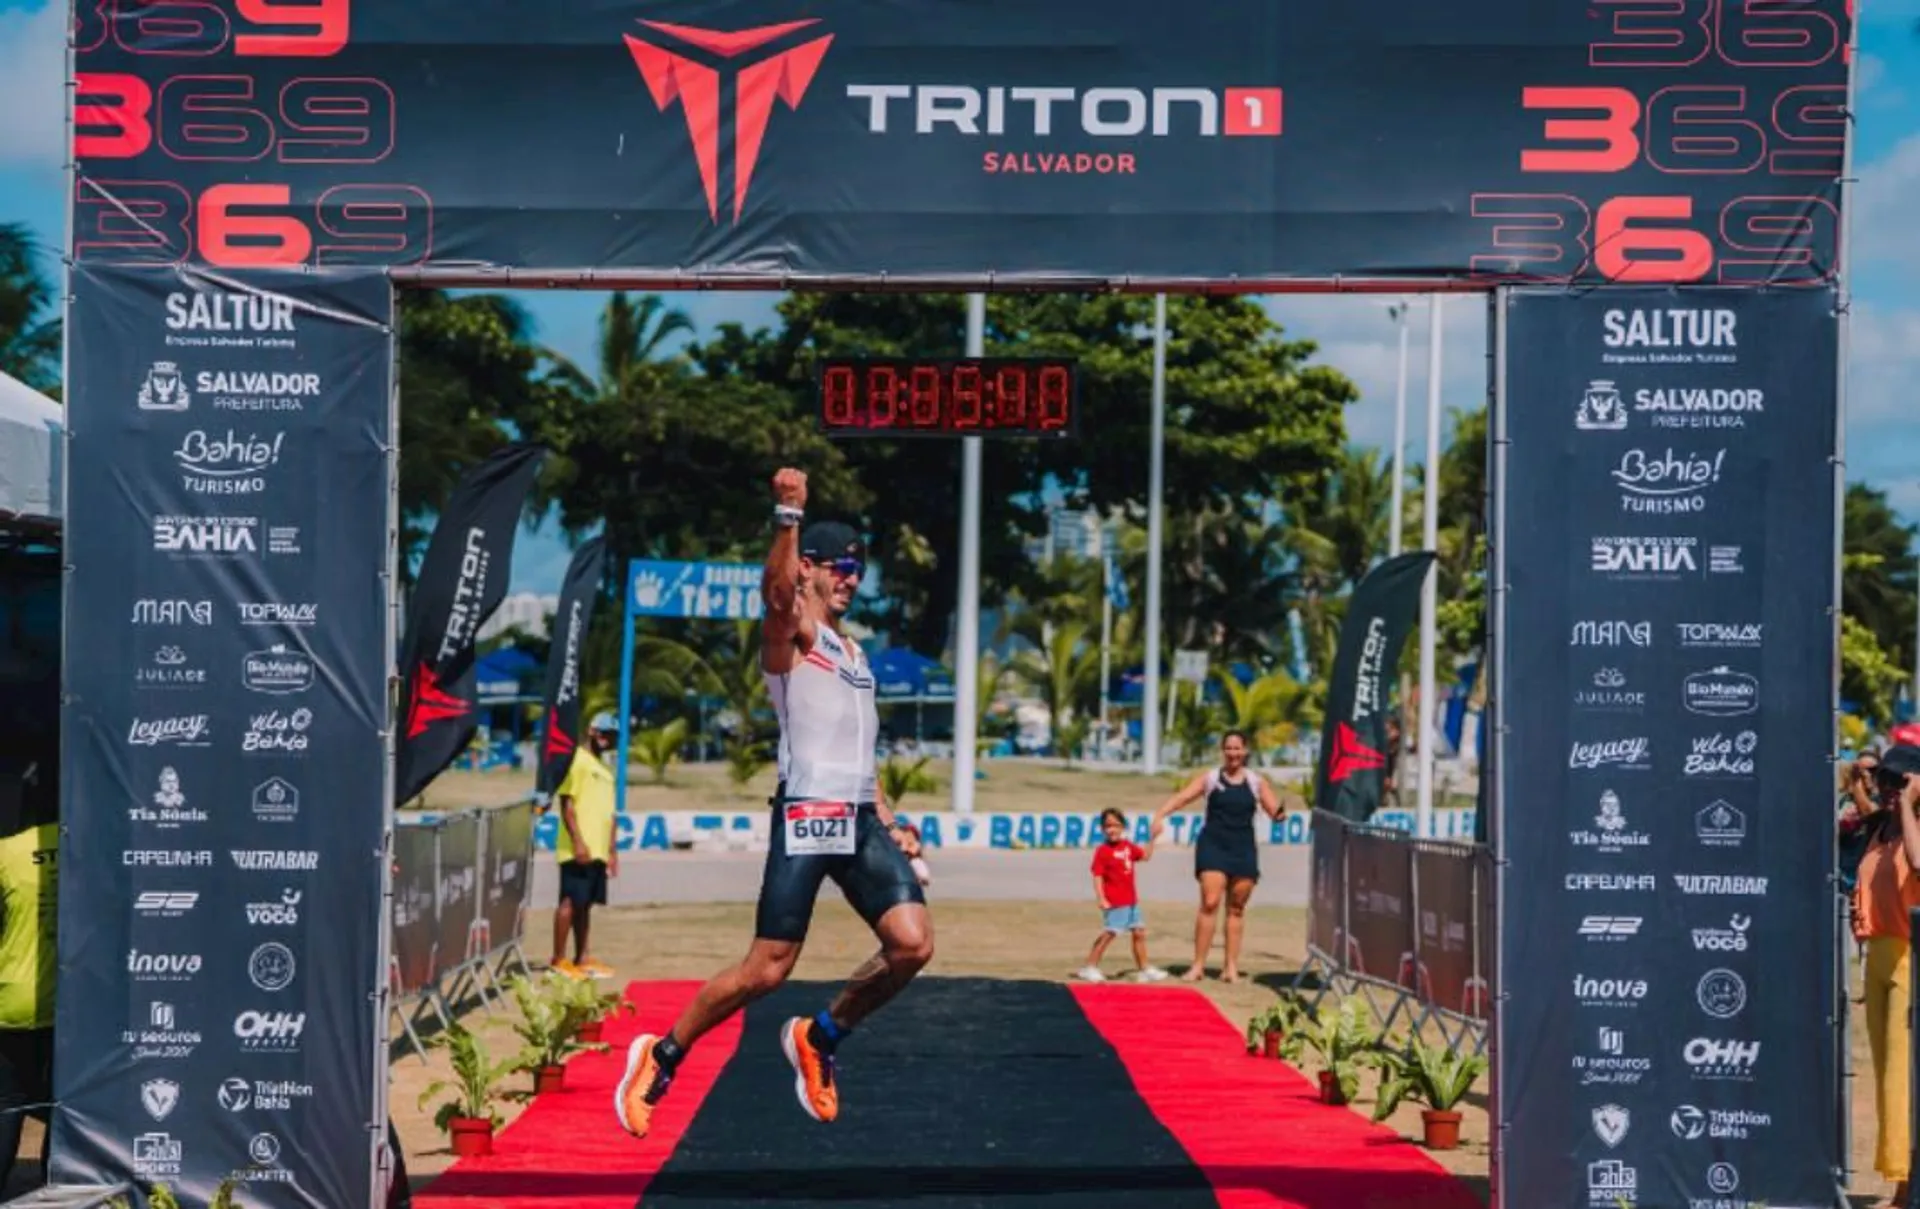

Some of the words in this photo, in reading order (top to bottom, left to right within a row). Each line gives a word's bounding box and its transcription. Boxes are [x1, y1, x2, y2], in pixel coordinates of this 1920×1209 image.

[75, 0, 350, 57] 69
[1589, 0, 1851, 67] 36
[74, 73, 395, 163] 369
[846, 84, 1218, 136] TRITON
[1520, 85, 1848, 175] 369
[983, 152, 1137, 174] SALVADOR
[75, 180, 434, 269] 369
[1470, 193, 1842, 285] 369
[165, 291, 296, 331] SALTUR
[1603, 308, 1738, 347] SALTUR
[196, 371, 321, 395] SALVADOR
[213, 396, 303, 410] PREFEITURA
[1634, 388, 1764, 411] SALVADOR
[1651, 414, 1745, 428] PREFEITURA
[183, 476, 266, 494] TURISMO
[1621, 494, 1706, 514] TURISMO
[153, 525, 257, 552] BAHIA
[1591, 545, 1697, 571] BAHIA
[128, 714, 210, 747] Legacy
[1568, 737, 1649, 769] Legacy
[794, 819, 848, 838] 6021
[122, 850, 213, 866] CAPELINHA
[231, 850, 319, 870] ULTRABAR
[1565, 873, 1655, 890] CAPELINHA
[1673, 874, 1769, 895] ULTRABAR
[127, 949, 202, 974] inova
[1573, 973, 1649, 999] inova
[234, 1010, 306, 1038] OHH
[1683, 1037, 1762, 1066] OHH
[254, 1080, 313, 1097] Triathlon
[254, 1096, 291, 1110] Bahia
[1708, 1109, 1772, 1126] Triathlon
[1708, 1125, 1748, 1139] Bahia
